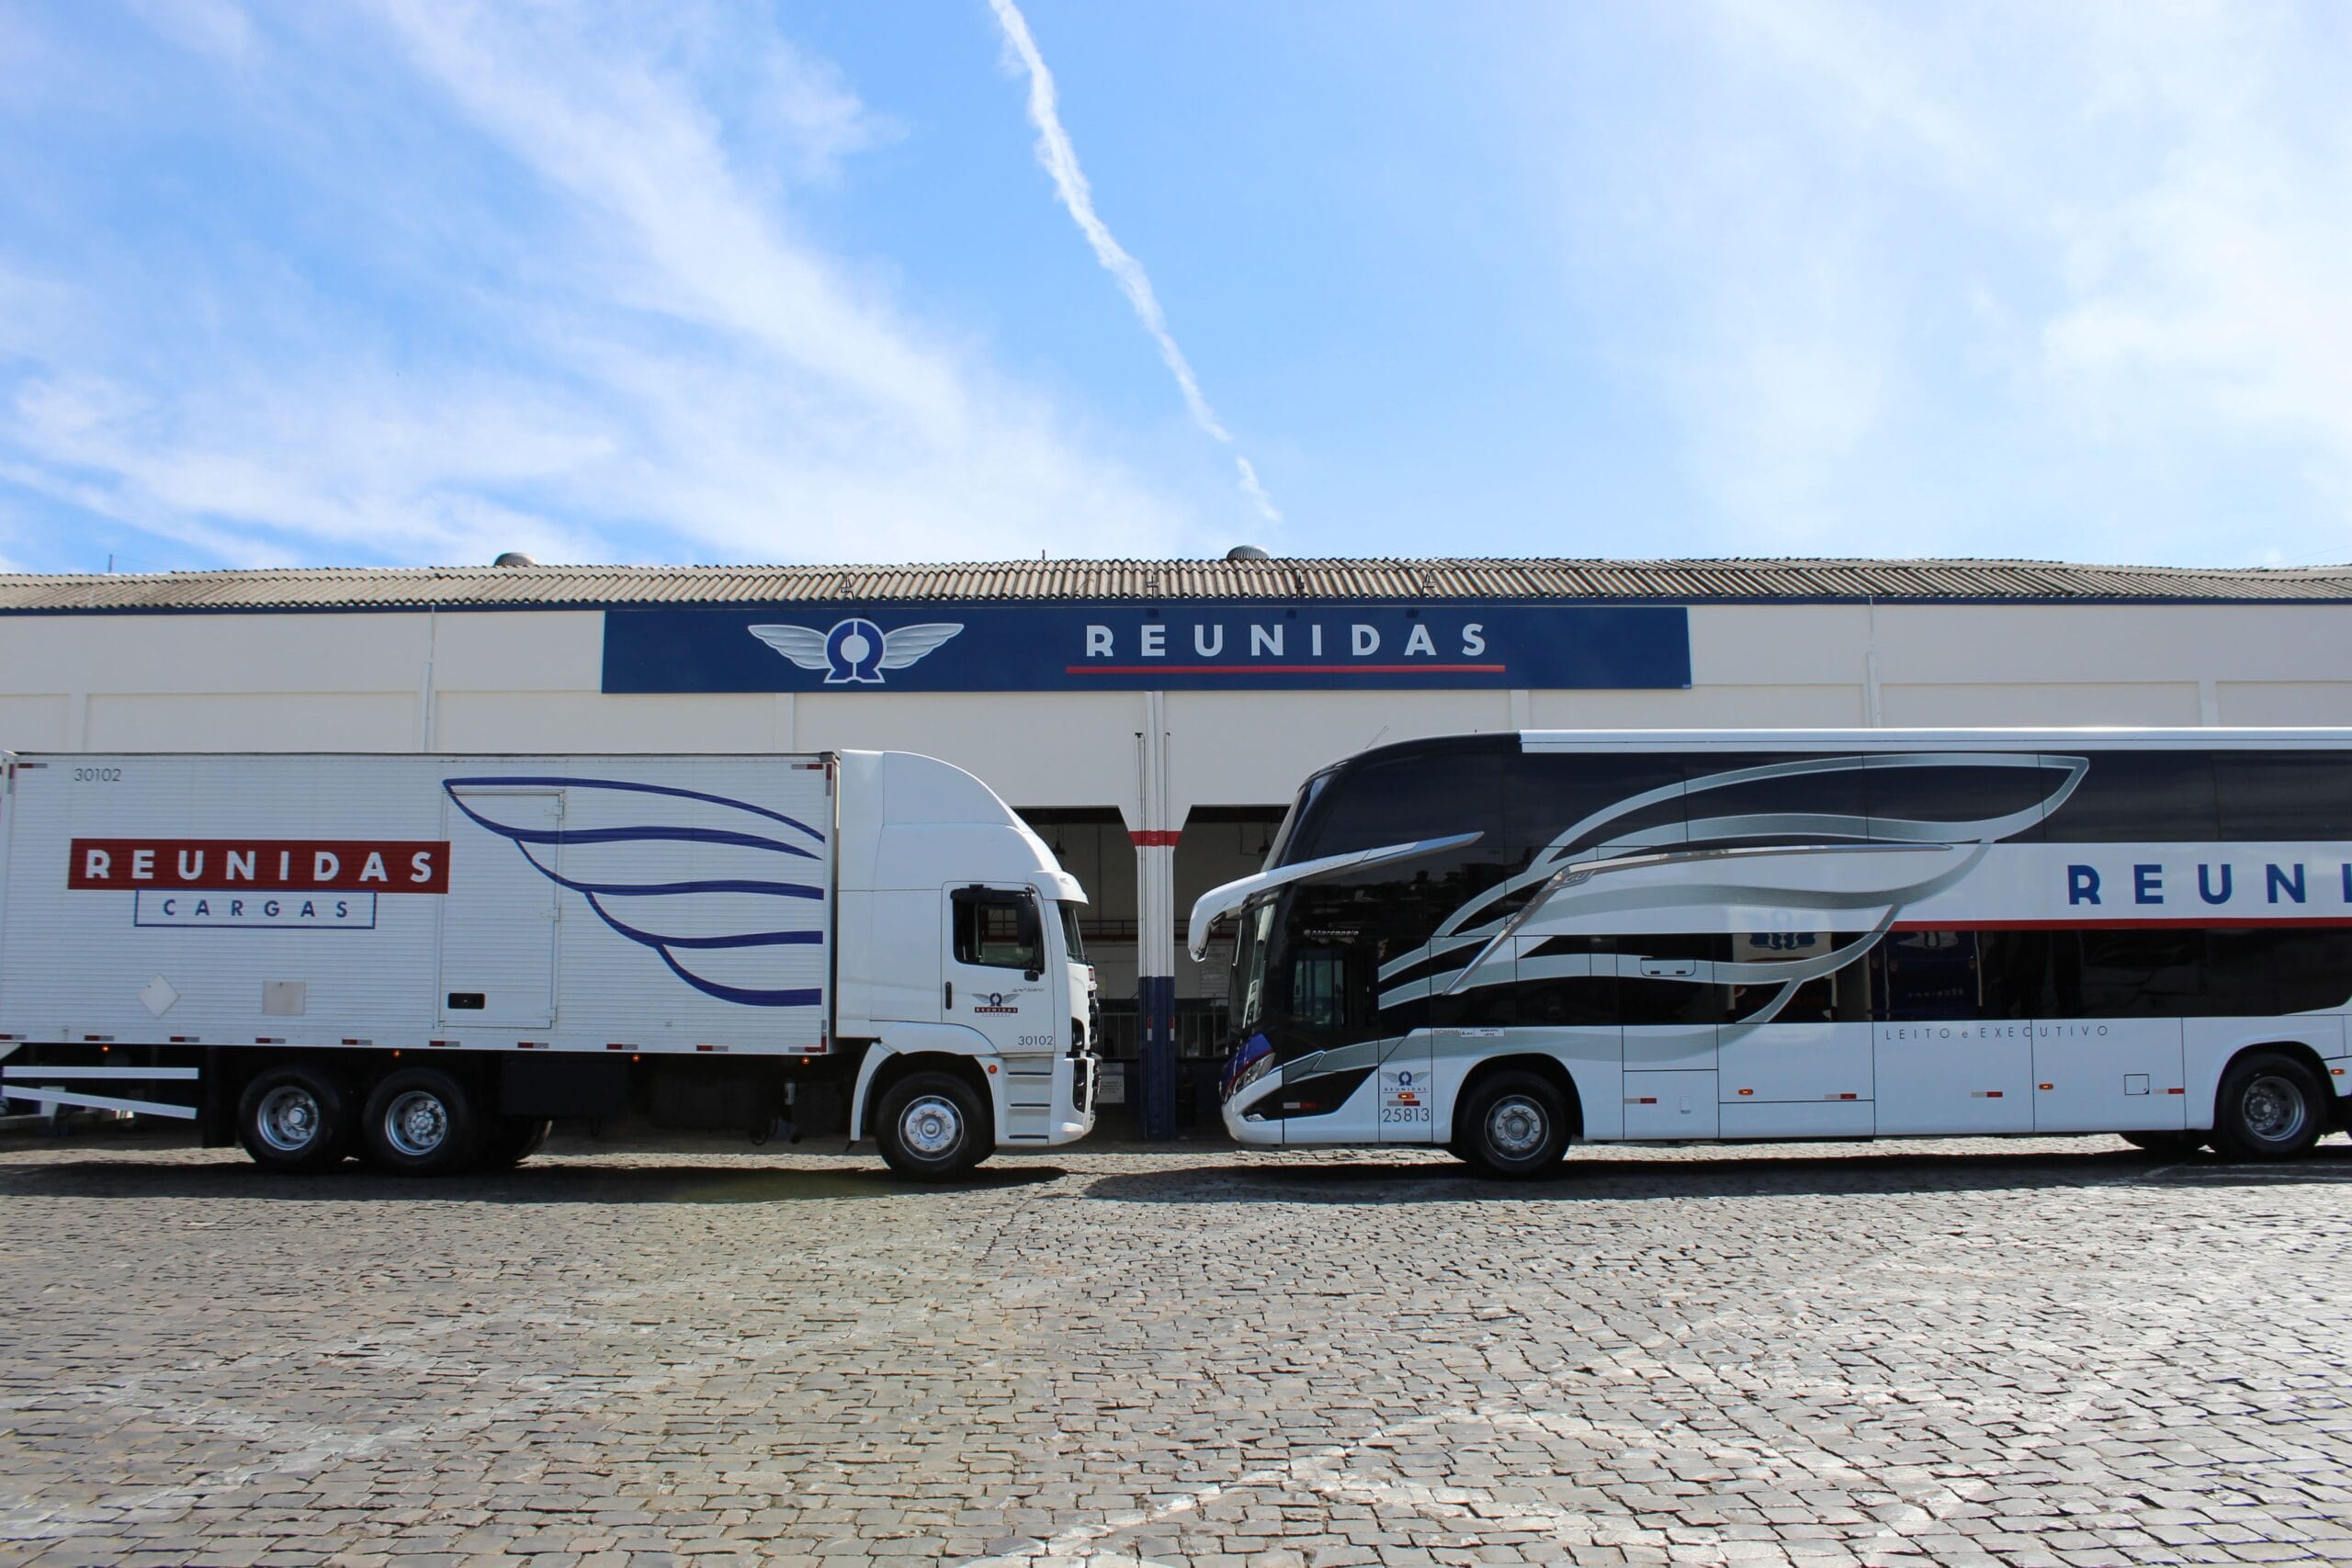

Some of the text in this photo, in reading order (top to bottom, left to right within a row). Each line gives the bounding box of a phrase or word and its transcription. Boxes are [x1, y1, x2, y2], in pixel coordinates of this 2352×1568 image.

[1085, 624, 1486, 657] REUNIDAS
[74, 768, 121, 782] 30102
[85, 849, 433, 883] REUNIDAS
[2067, 863, 2352, 906] REUNI
[164, 898, 348, 919] CARGAS
[1018, 1035, 1054, 1046] 30102
[1885, 1025, 2109, 1041] LEITO e EXECUTIVO
[1382, 1108, 1430, 1122] 25813
